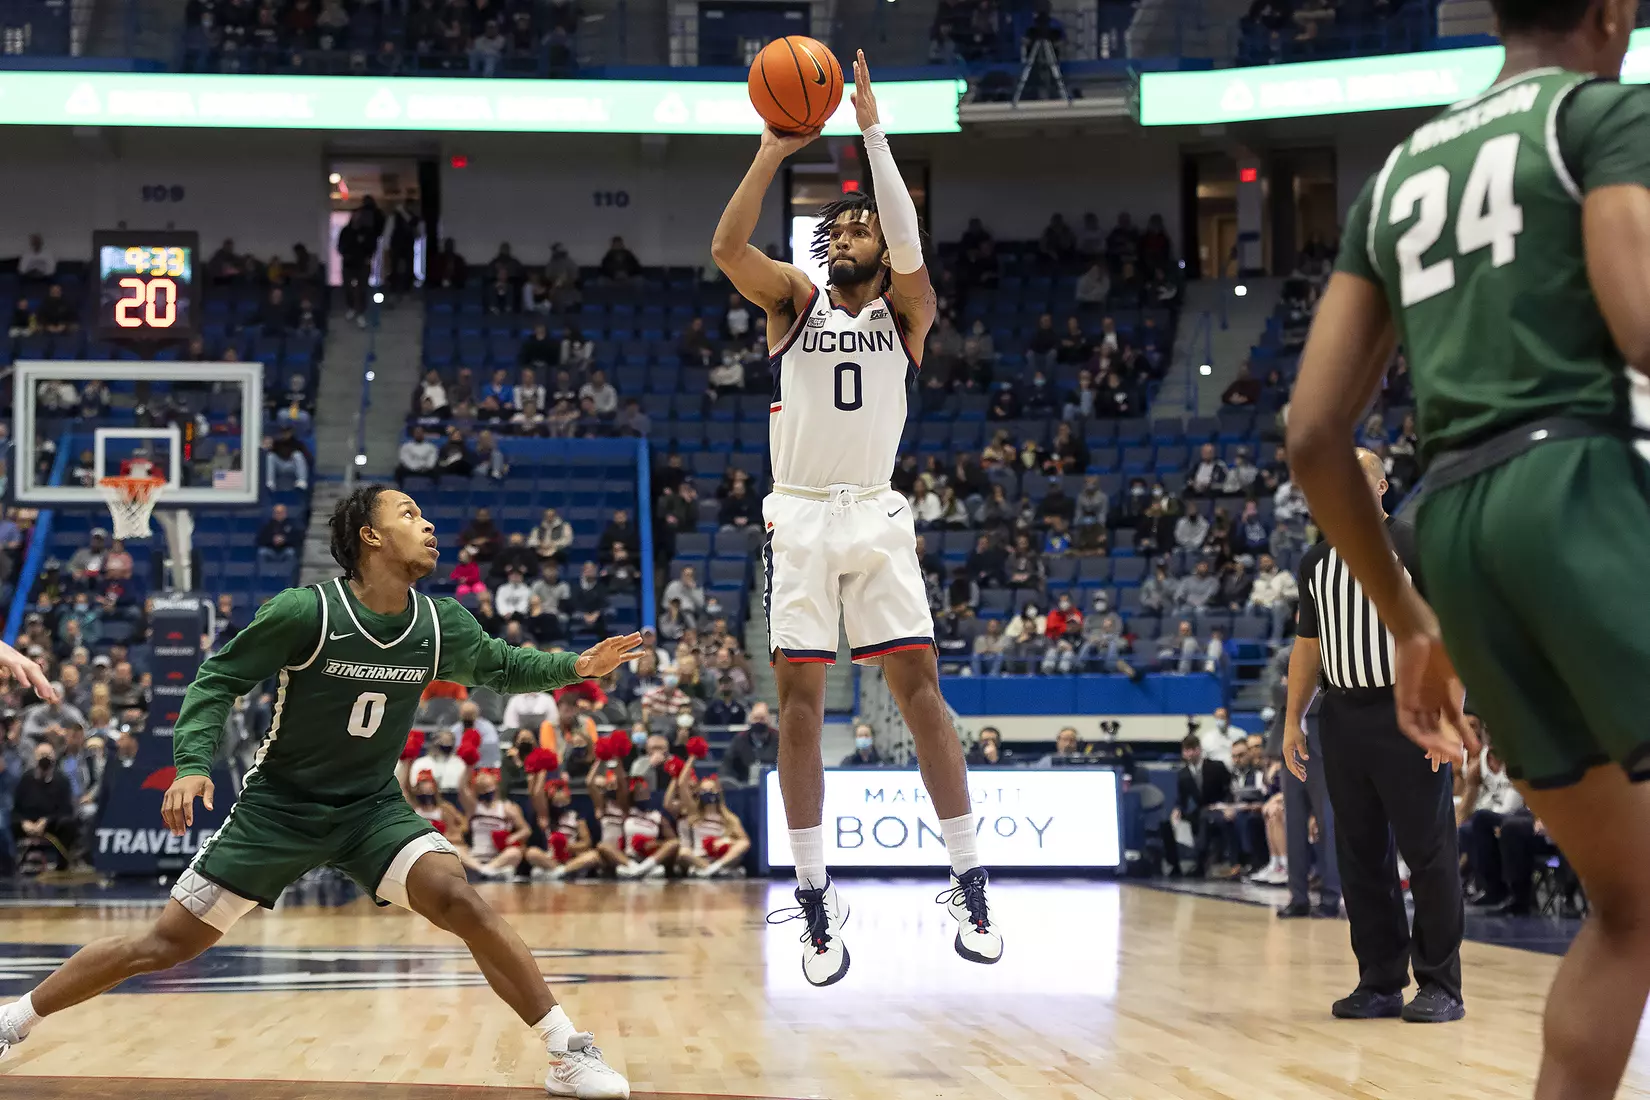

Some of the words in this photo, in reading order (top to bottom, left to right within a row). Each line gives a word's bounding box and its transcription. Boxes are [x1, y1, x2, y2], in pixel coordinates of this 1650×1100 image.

[592, 190, 630, 208] 110
[1389, 132, 1523, 308] 24
[125, 246, 185, 277] 9:33
[115, 277, 177, 328] 20
[802, 330, 894, 353] UCONN
[834, 362, 862, 411] 0
[325, 661, 425, 681] BINGHAMTON
[347, 691, 388, 738] 0
[865, 788, 1021, 804] MAROTT
